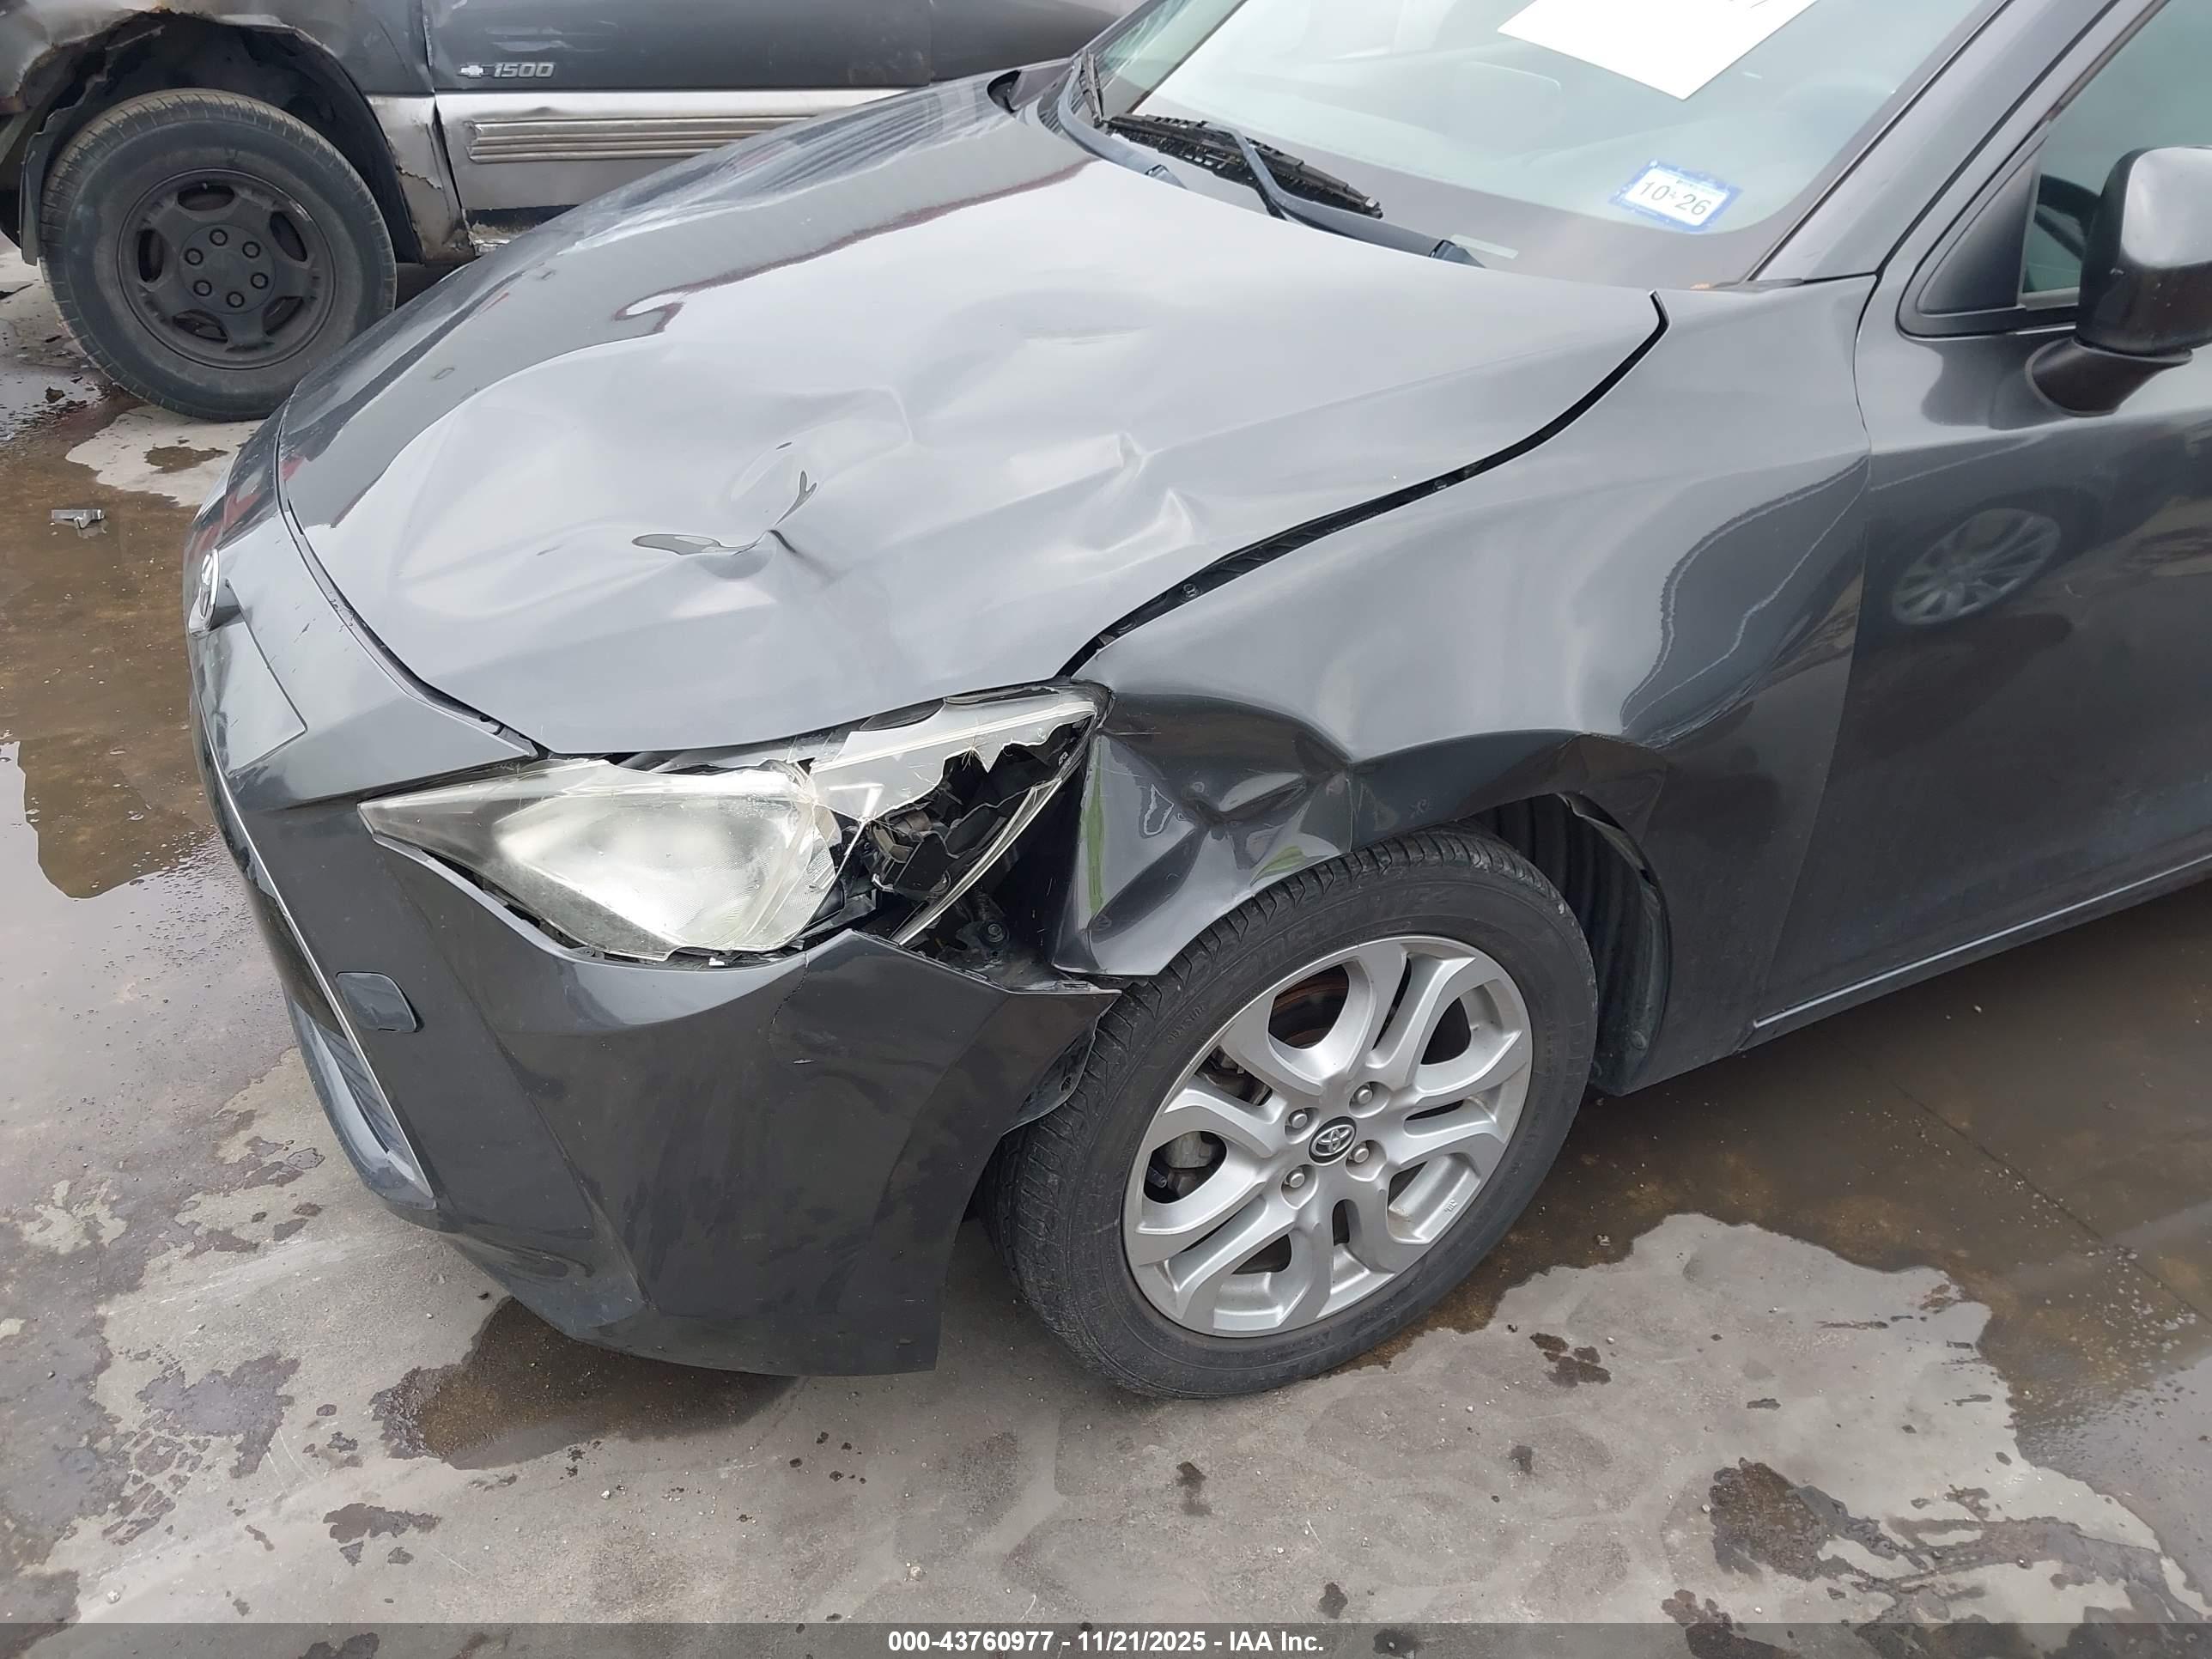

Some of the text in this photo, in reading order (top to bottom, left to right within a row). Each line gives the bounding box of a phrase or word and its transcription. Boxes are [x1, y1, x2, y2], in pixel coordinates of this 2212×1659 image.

[494, 63, 555, 78] 1500
[1640, 181, 1670, 201] 10
[1674, 193, 1711, 216] 26
